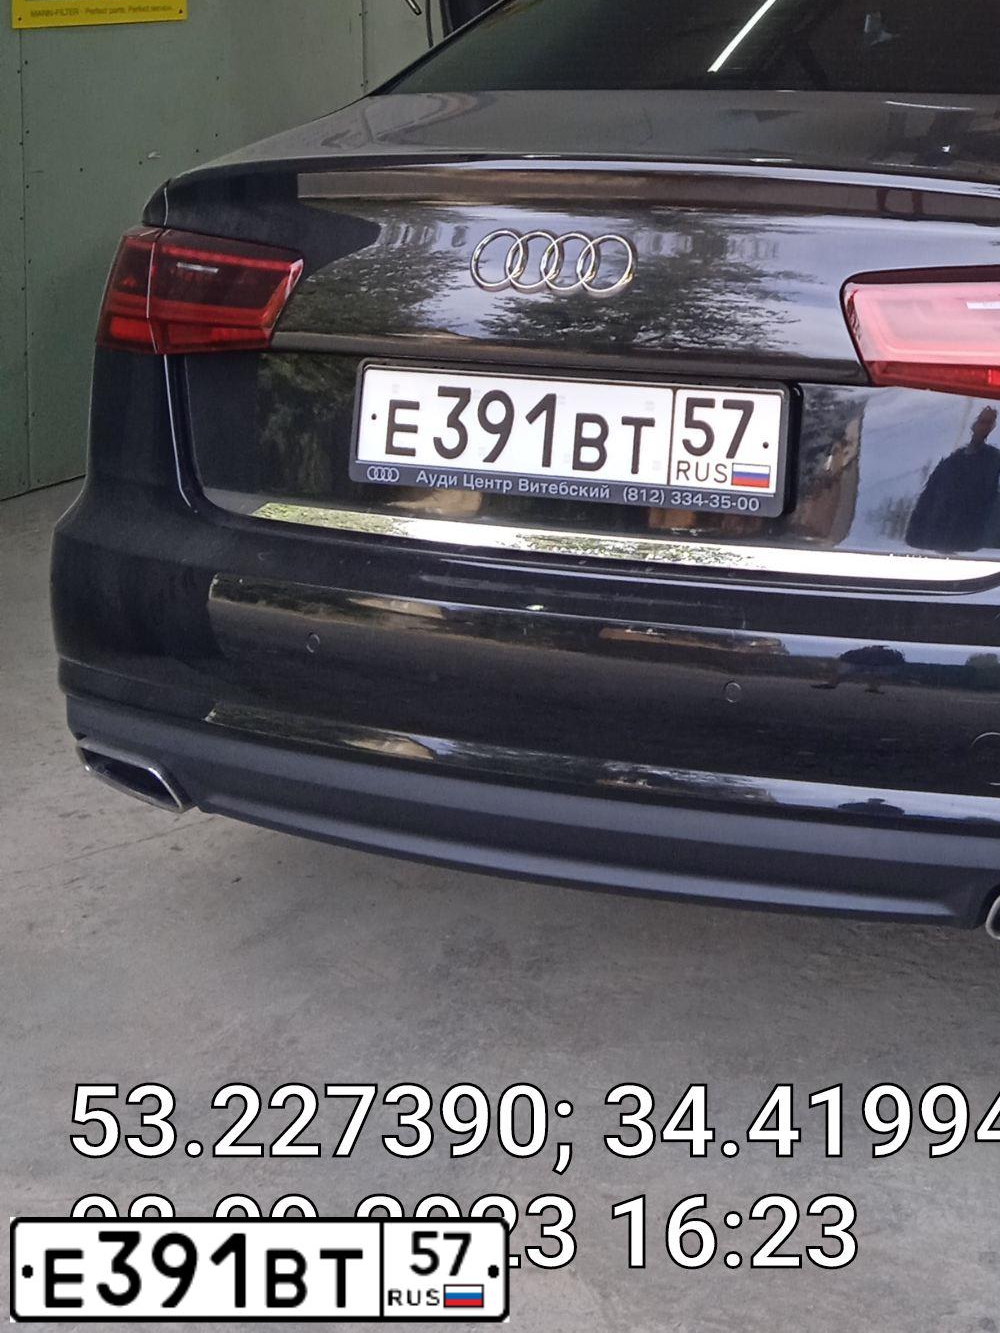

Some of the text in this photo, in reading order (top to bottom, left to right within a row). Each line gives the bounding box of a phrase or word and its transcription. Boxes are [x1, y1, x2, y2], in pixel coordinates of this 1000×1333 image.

[385, 385, 755, 475] Е391ВТ 57
[415, 470, 761, 513] Ауди Центр Витебский (812) 334-35-00
[675, 460, 728, 484] RUS
